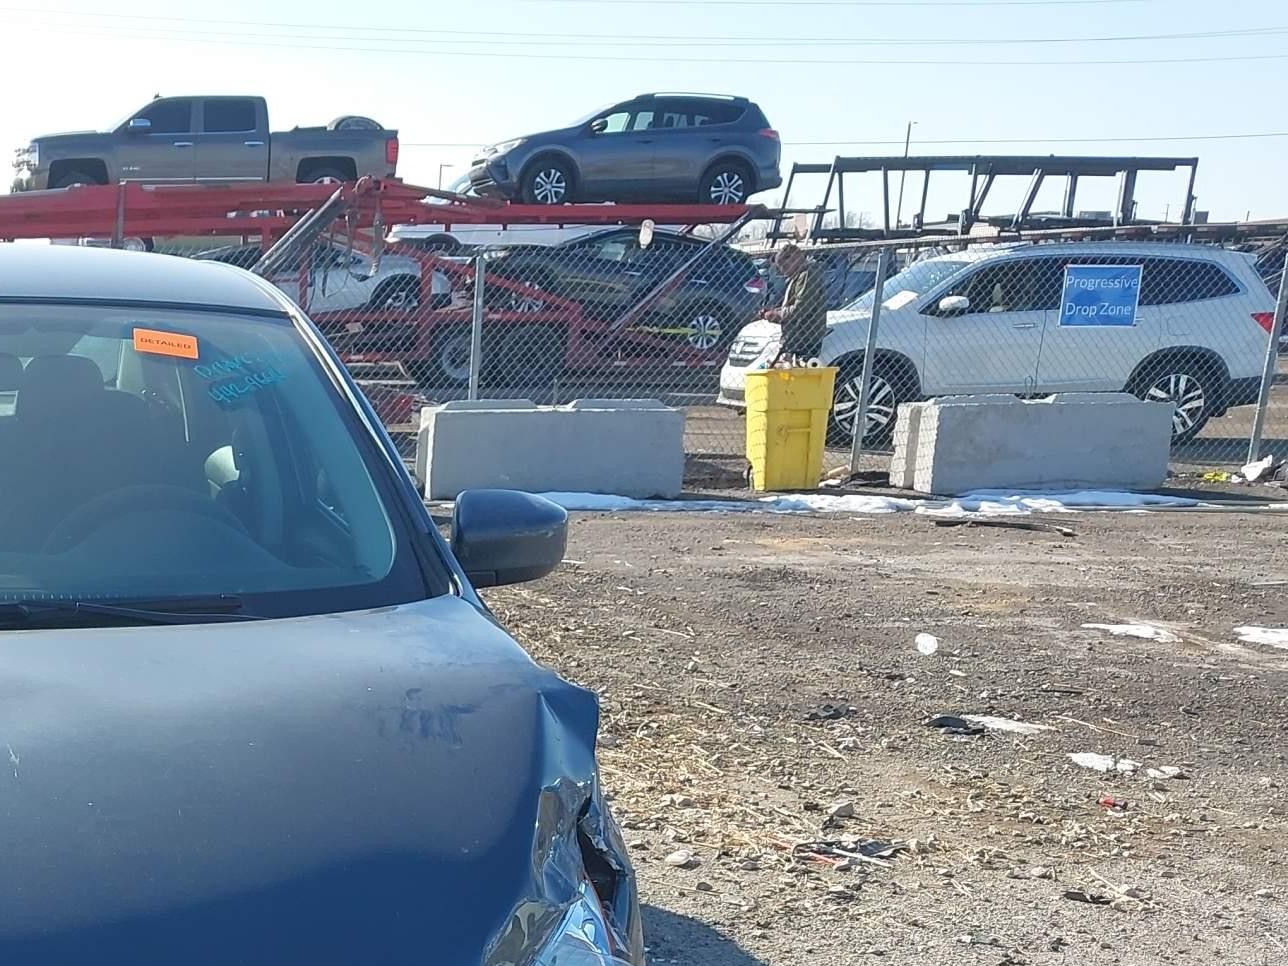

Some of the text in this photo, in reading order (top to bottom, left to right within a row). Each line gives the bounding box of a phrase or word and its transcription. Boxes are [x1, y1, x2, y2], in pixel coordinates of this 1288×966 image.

[1066, 275, 1138, 290] Progressive
[1065, 302, 1132, 318] Drop Zone
[140, 337, 191, 349] DETAILED
